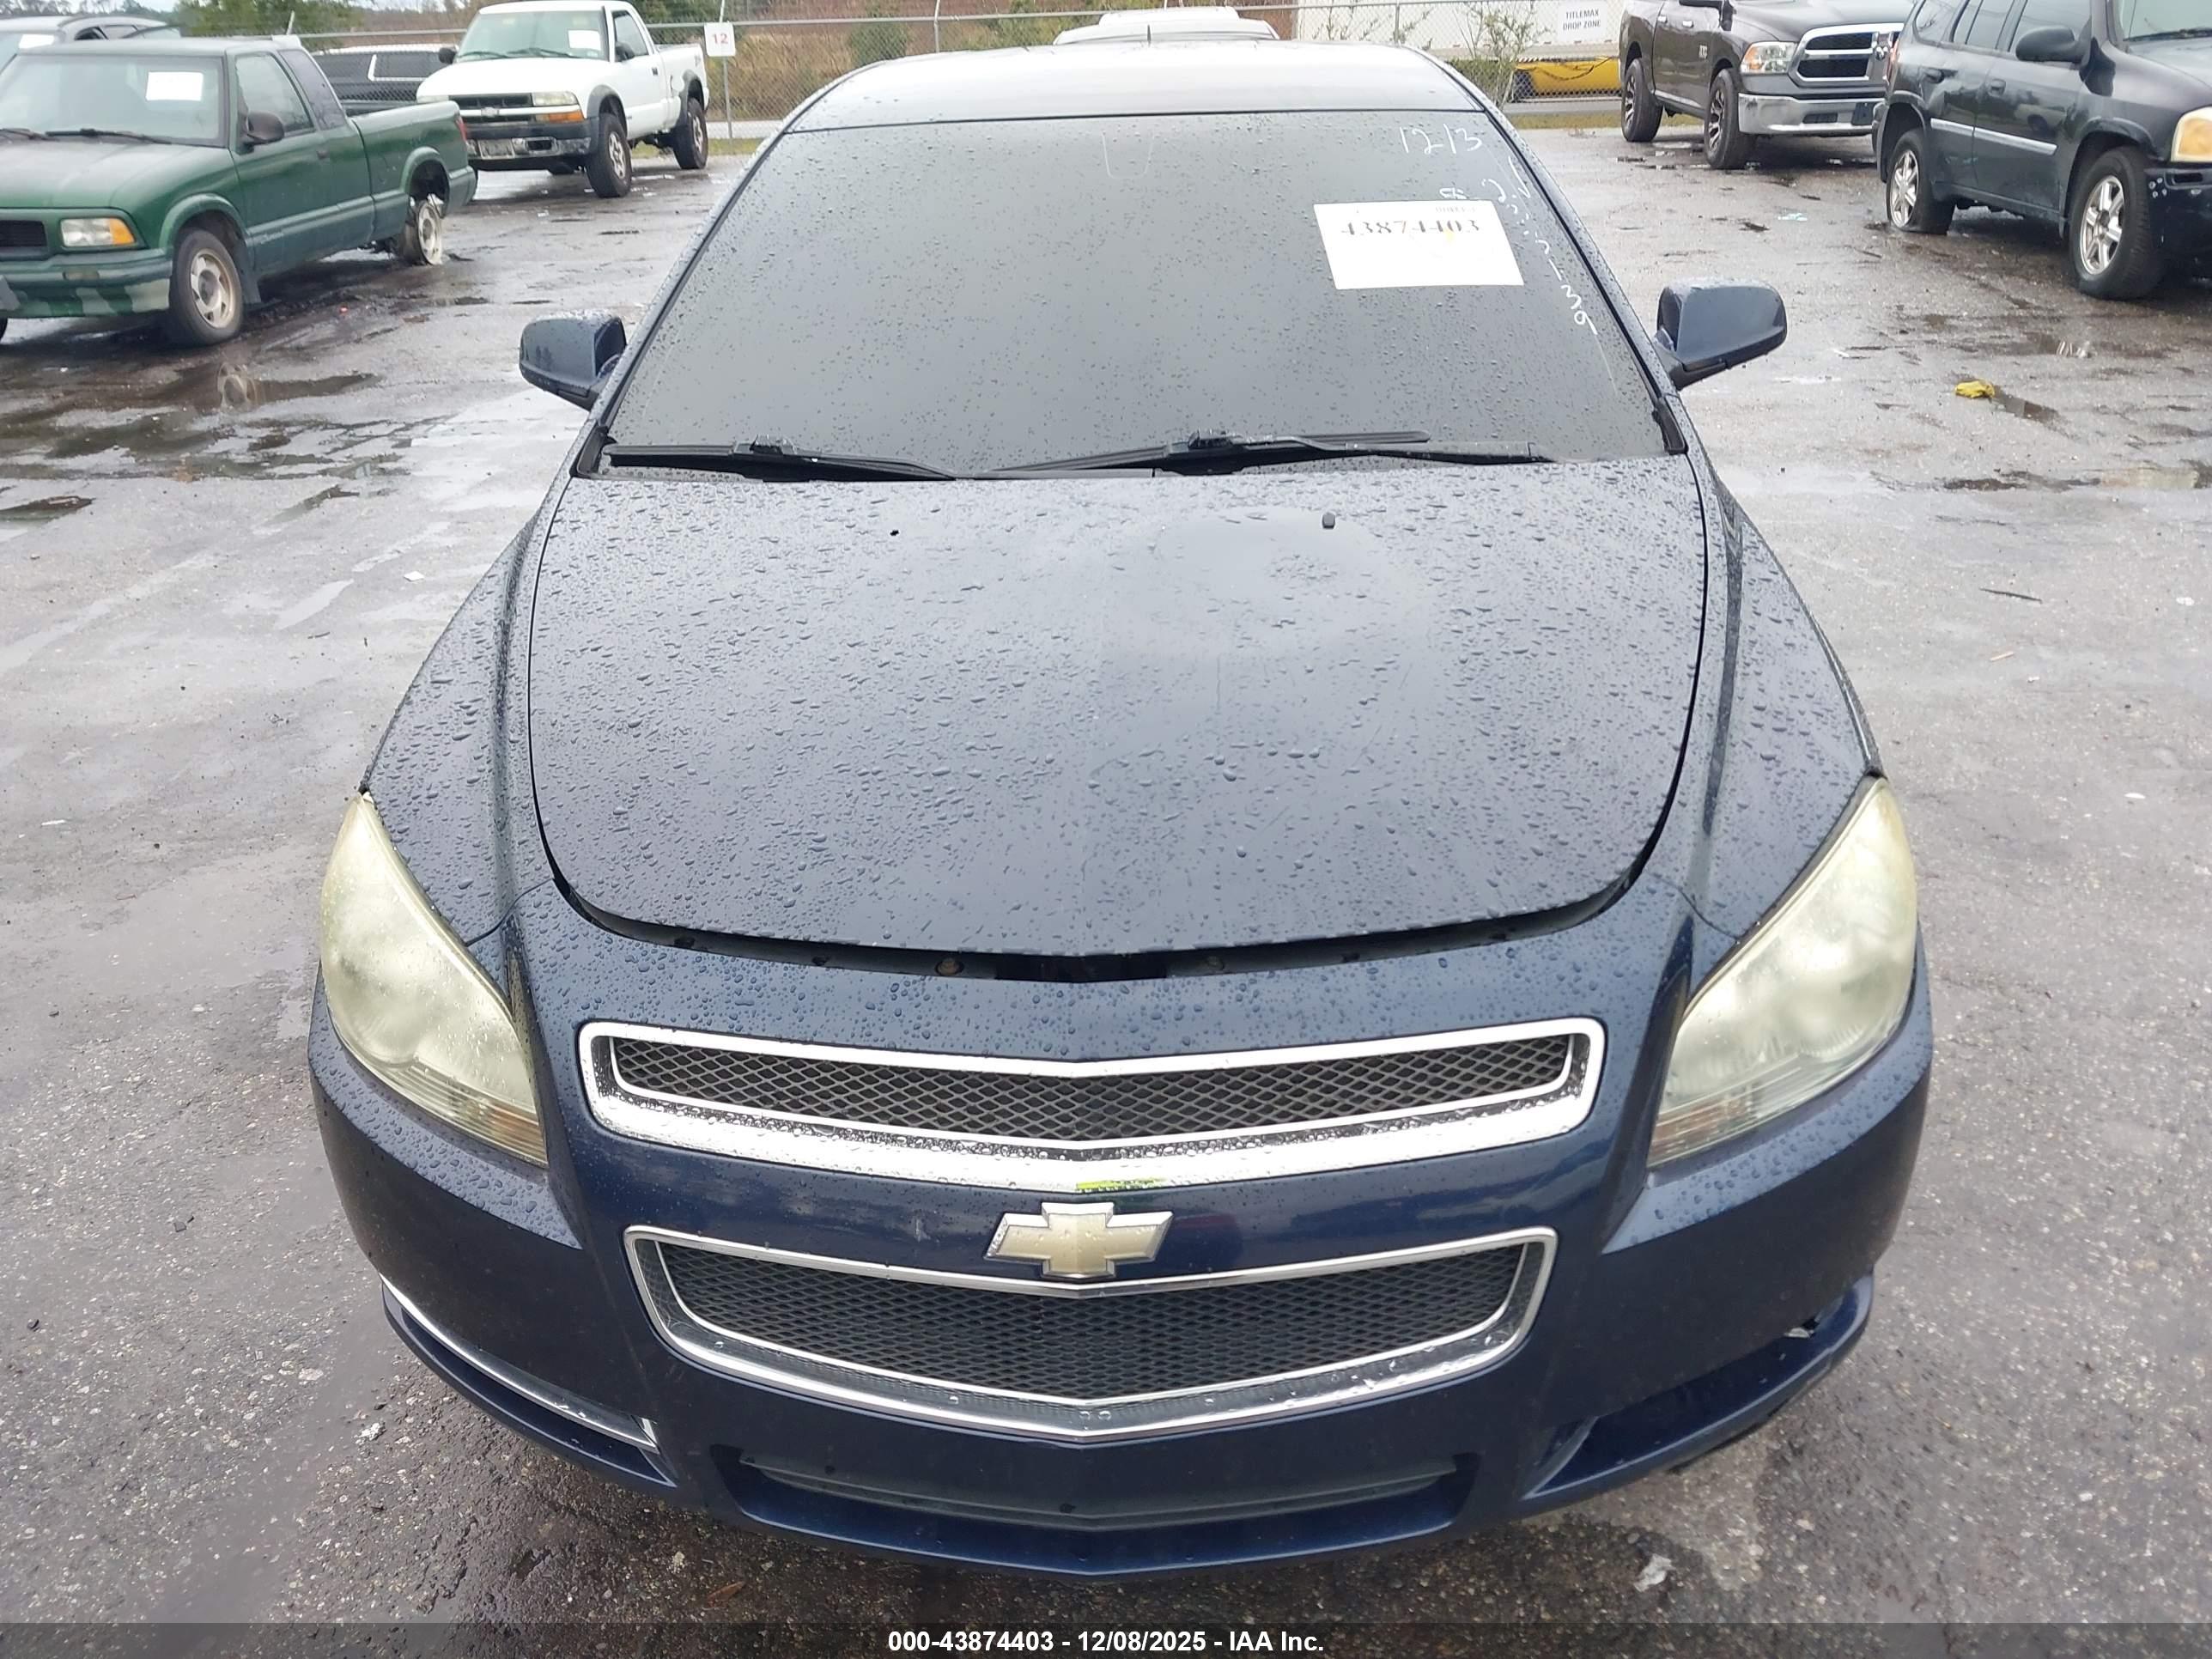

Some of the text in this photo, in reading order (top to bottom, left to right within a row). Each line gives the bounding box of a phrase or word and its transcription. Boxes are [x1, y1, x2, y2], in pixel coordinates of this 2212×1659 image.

[1565, 9, 1599, 19] TITLEMAX
[1563, 20, 1601, 31] DROP ZONE
[712, 33, 728, 44] 12
